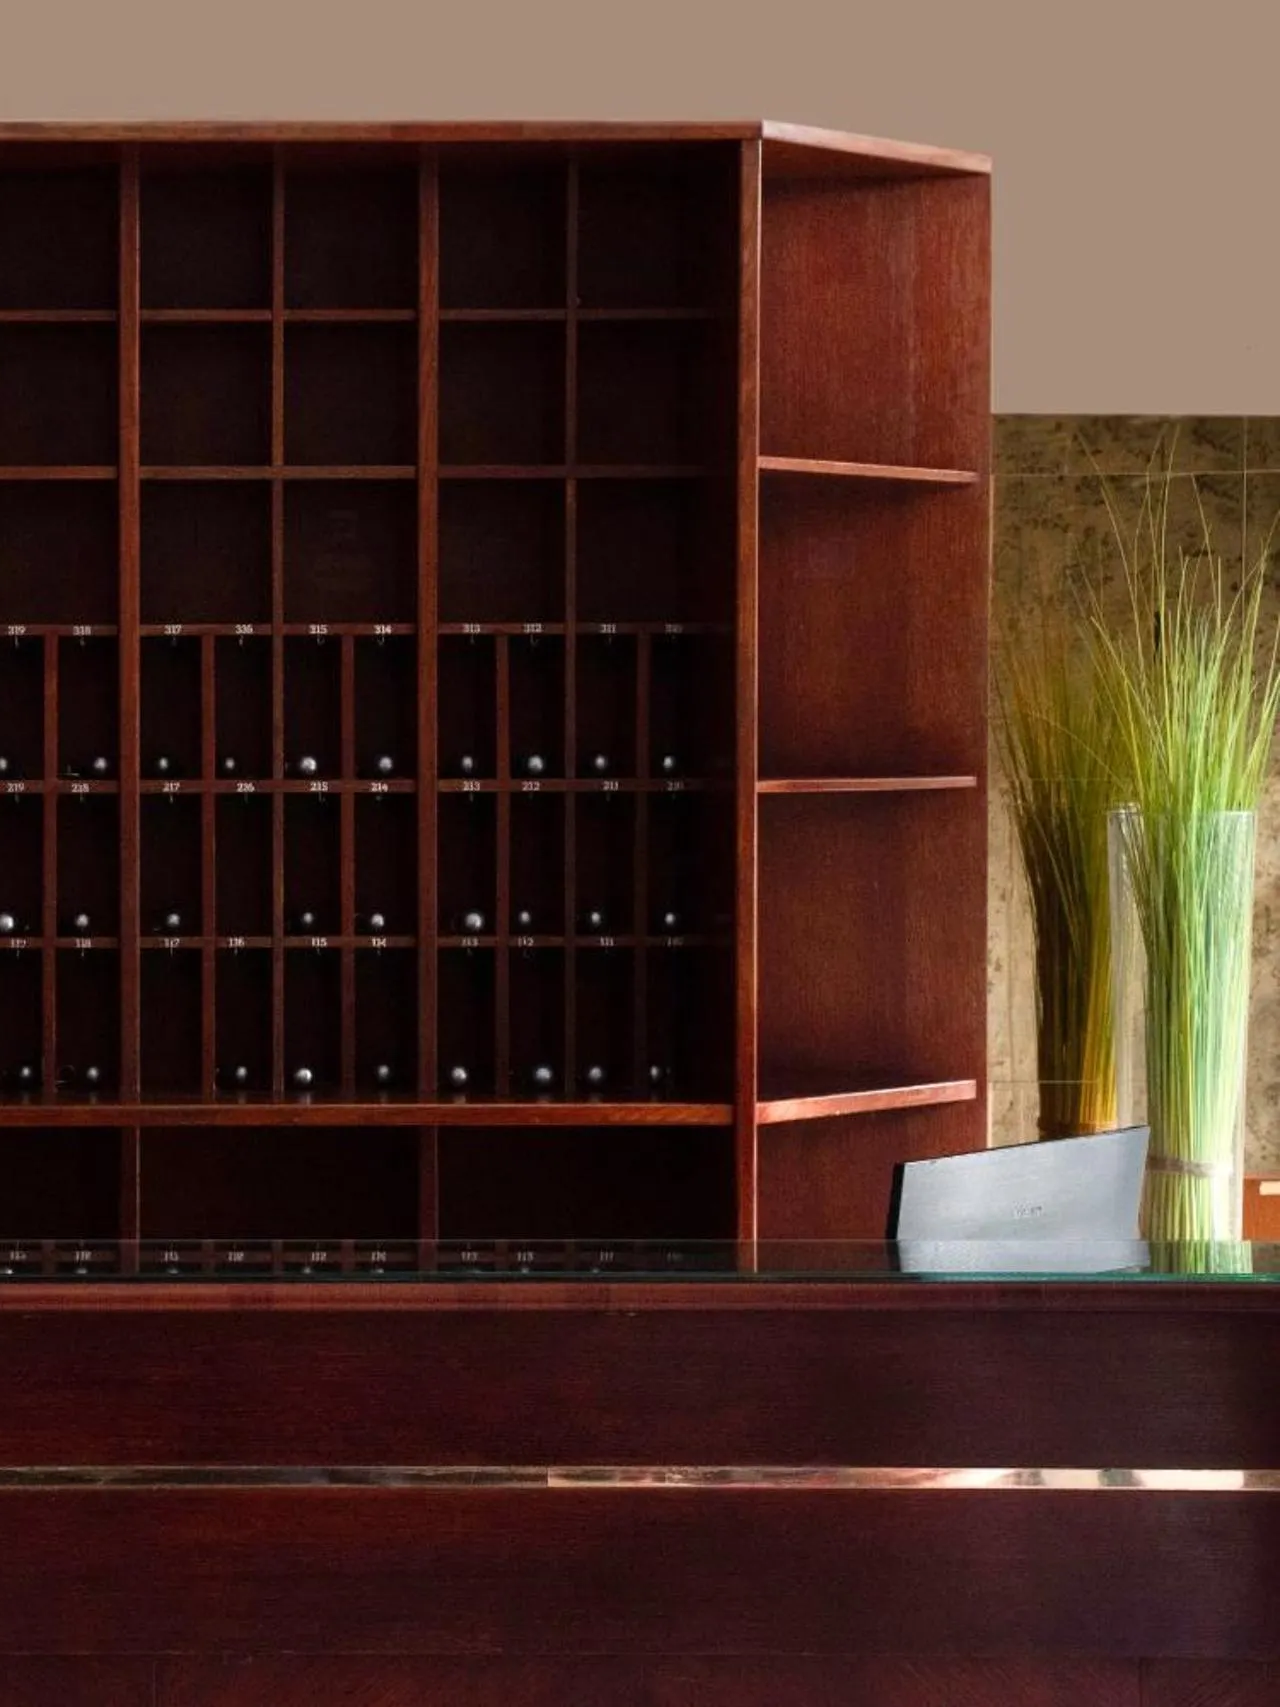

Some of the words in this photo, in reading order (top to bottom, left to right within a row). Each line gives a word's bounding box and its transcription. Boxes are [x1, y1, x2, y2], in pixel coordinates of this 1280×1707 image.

[164, 624, 183, 635] 317
[309, 624, 328, 635] 315
[374, 624, 392, 635] 314
[6, 782, 25, 793] 219
[162, 781, 181, 793] 217
[309, 781, 329, 792] 215
